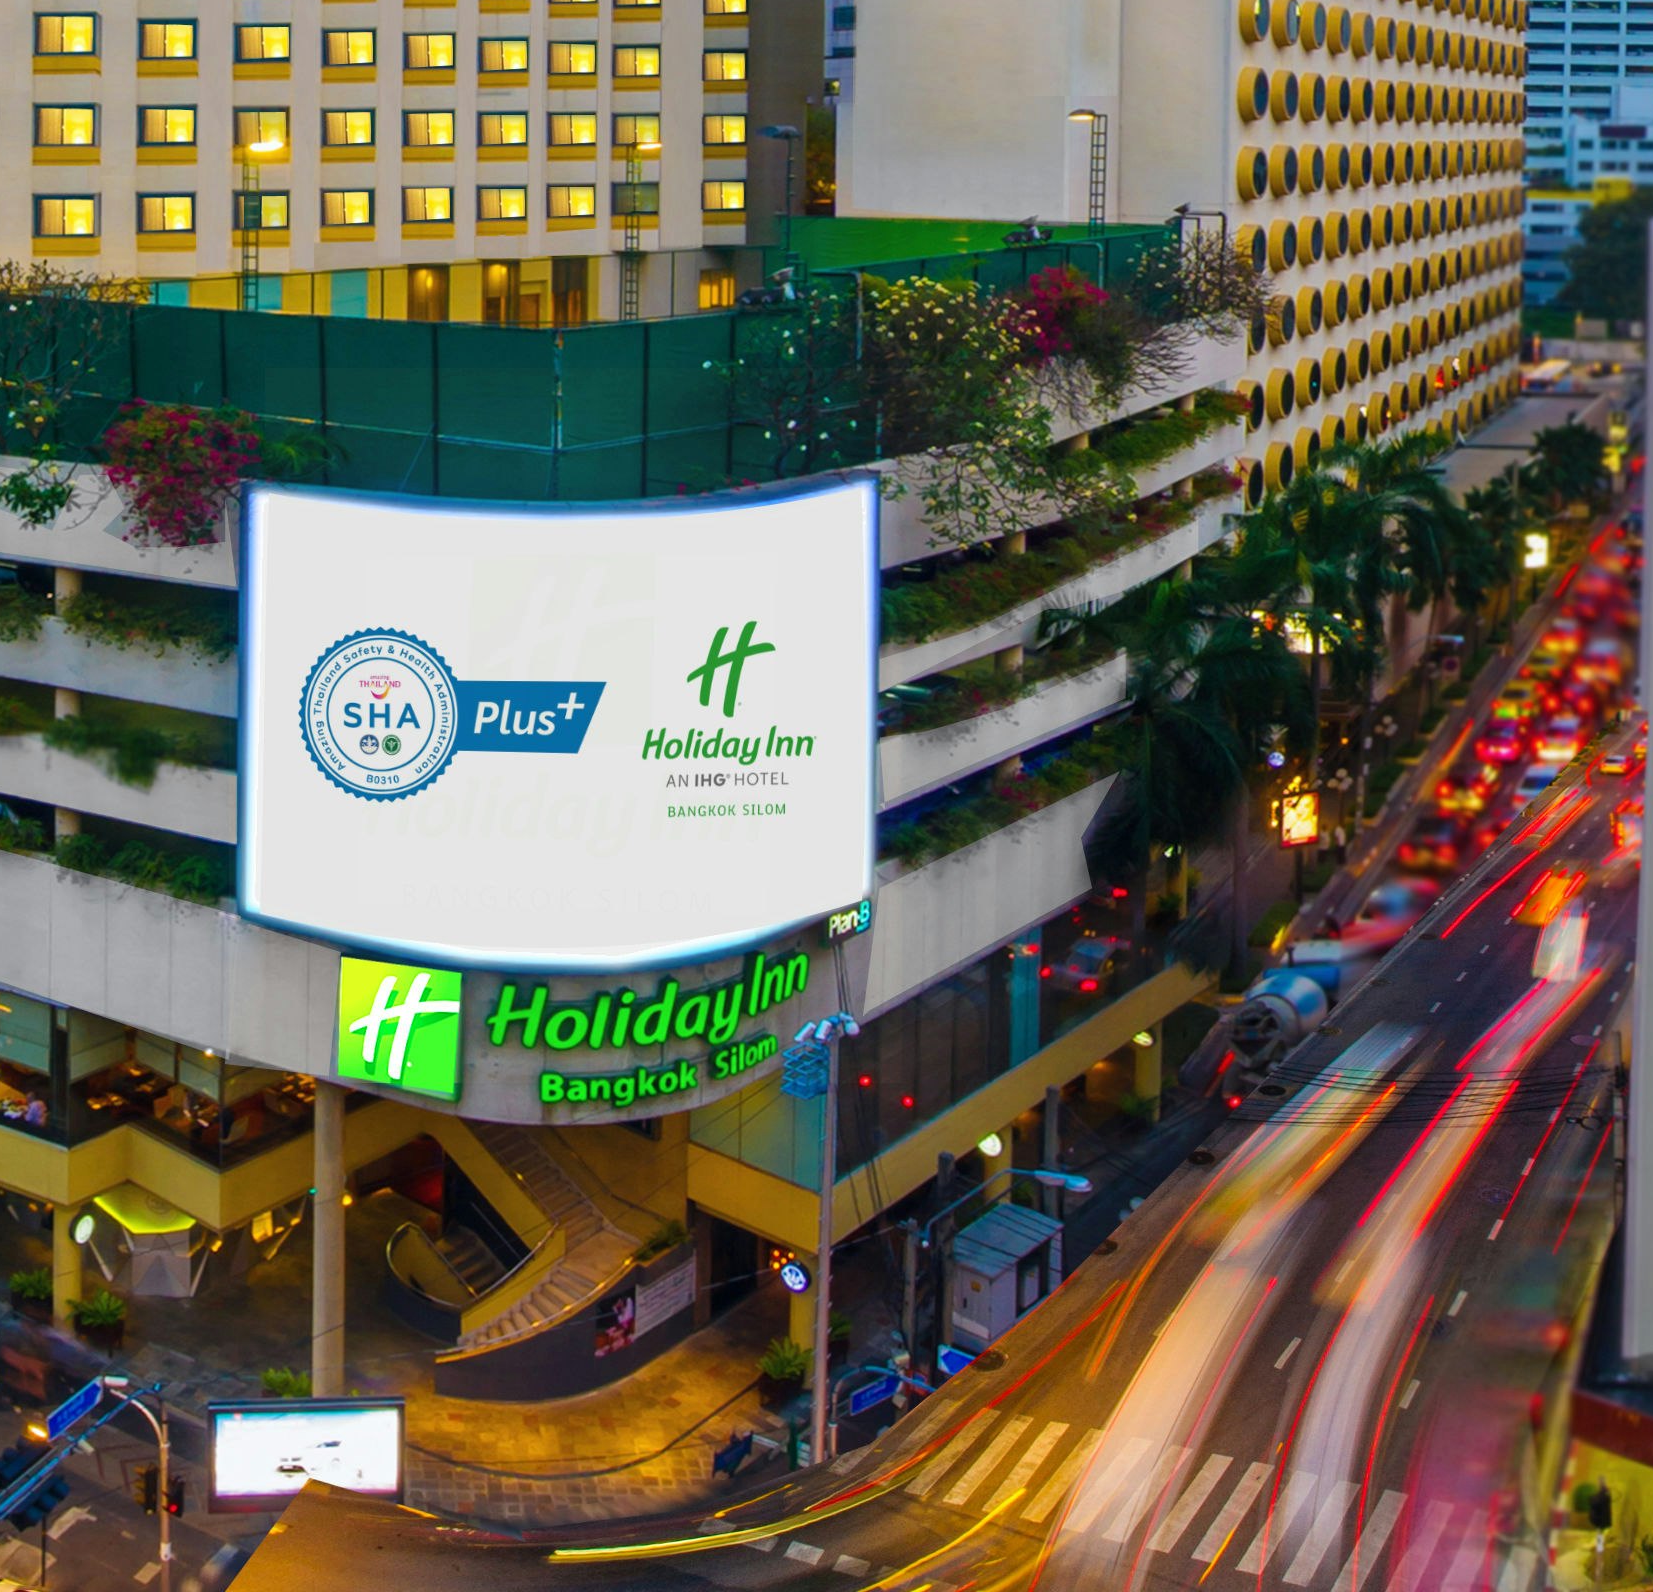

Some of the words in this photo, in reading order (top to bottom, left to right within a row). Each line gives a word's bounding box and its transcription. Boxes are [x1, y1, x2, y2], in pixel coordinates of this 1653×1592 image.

[343, 645, 383, 664] Safety
[387, 645, 395, 654] &
[399, 648, 435, 680] Health
[313, 662, 342, 715] Thailand
[359, 680, 401, 688] THAILAND
[343, 702, 421, 729] SHA
[415, 683, 451, 774] Administration
[316, 720, 346, 771] Amazing
[642, 727, 761, 765] Holiday
[765, 725, 815, 757] Inn
[366, 774, 400, 785] B0310
[666, 774, 689, 788] AN
[734, 772, 789, 786] HOTEL
[667, 805, 736, 818] BANGKOK
[743, 803, 786, 816] SILOM
[487, 980, 744, 1050] Holiday
[747, 952, 809, 1011] Inn
[539, 1060, 698, 1108] Bangkok
[715, 1032, 778, 1080] Silom
